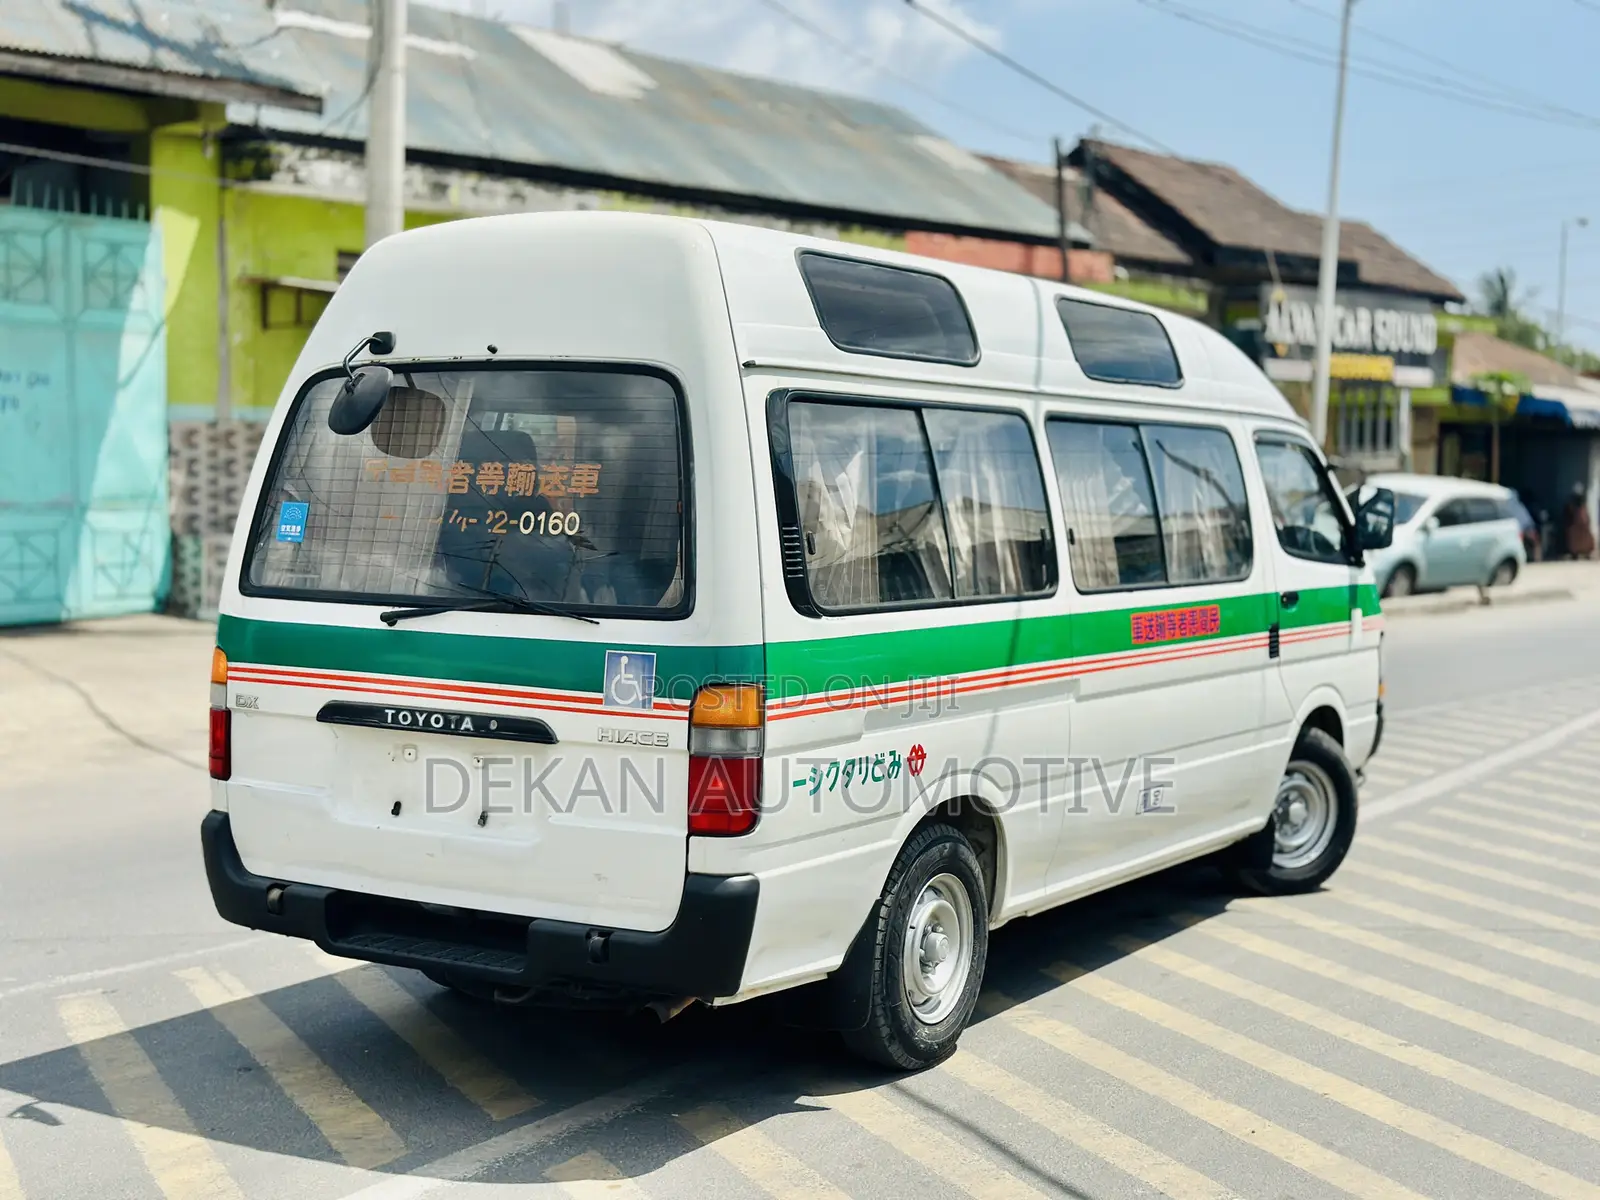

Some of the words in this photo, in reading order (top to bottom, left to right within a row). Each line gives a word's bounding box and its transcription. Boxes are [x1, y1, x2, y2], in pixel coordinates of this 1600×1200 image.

[235, 694, 260, 710] DX
[384, 708, 474, 731] TOYOTA
[598, 727, 670, 748] HIACE
